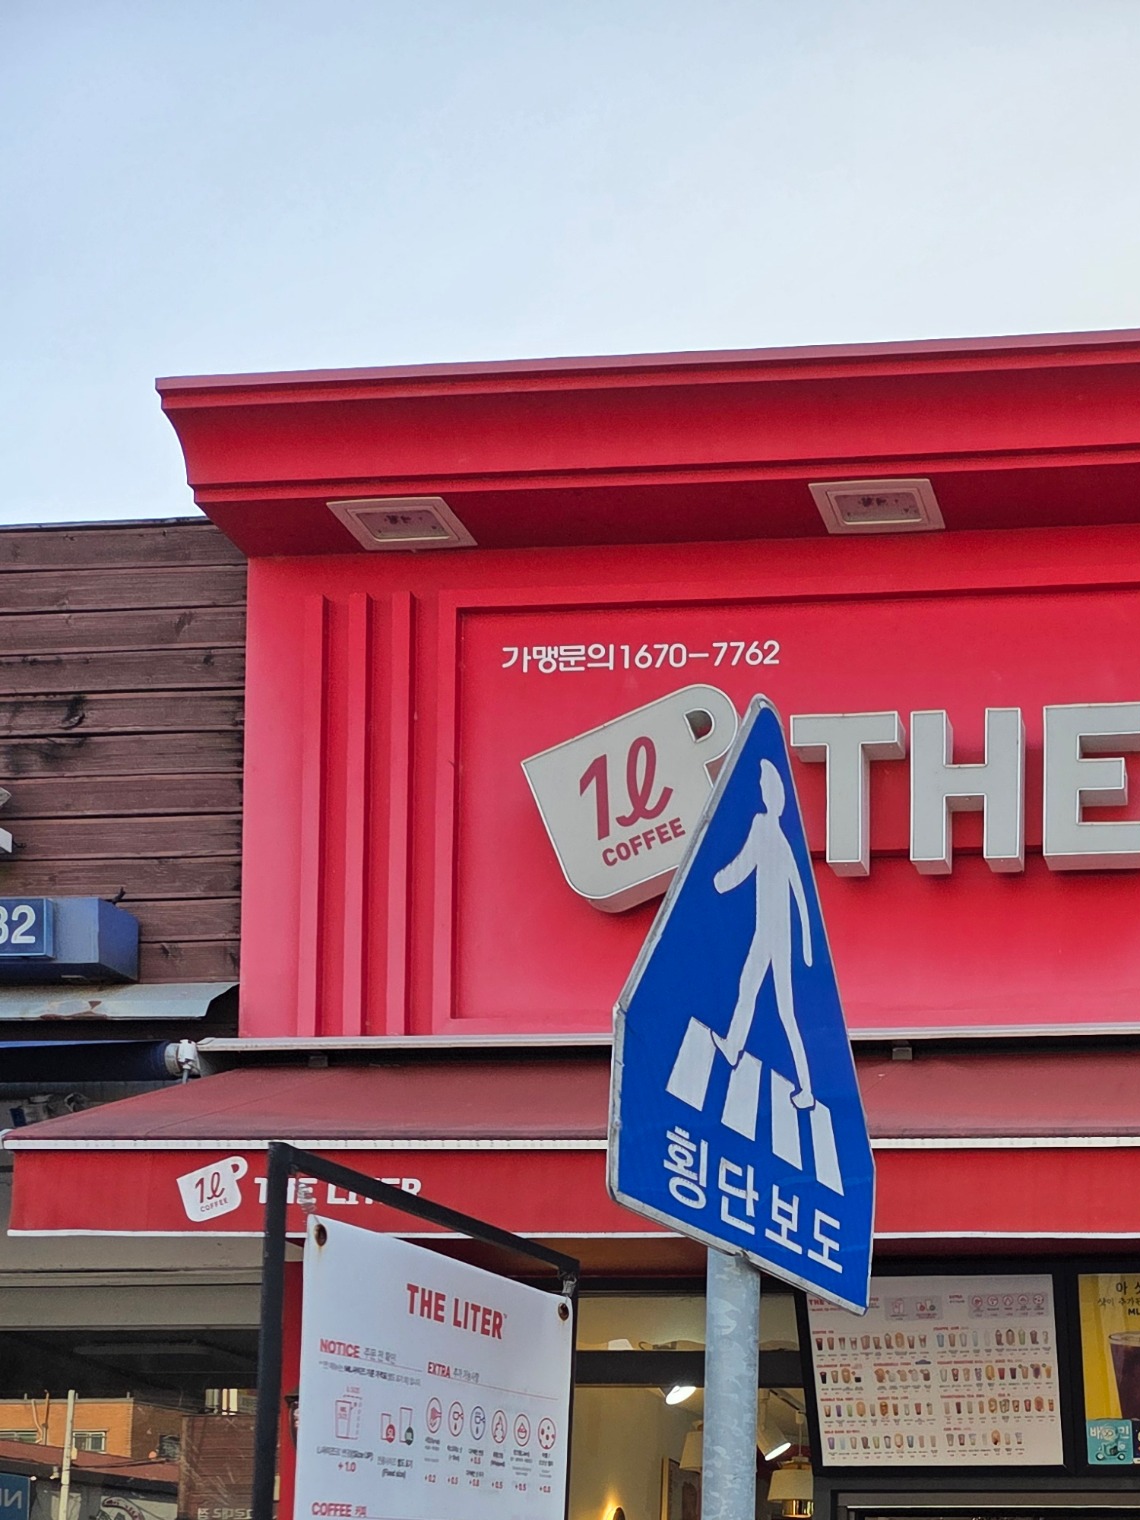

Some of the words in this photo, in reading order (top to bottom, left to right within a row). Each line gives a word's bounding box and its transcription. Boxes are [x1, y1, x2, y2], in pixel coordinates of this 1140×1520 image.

[602, 817, 686, 867] COFFEE
[200, 1197, 228, 1213] COFFEE
[663, 1126, 843, 1274] 횡단보도
[406, 1283, 446, 1323] THE
[452, 1297, 504, 1340] LITER
[1128, 1307, 1140, 1316] ML
[319, 1338, 361, 1359] NOTICE
[311, 1501, 352, 1517] COFFEE
